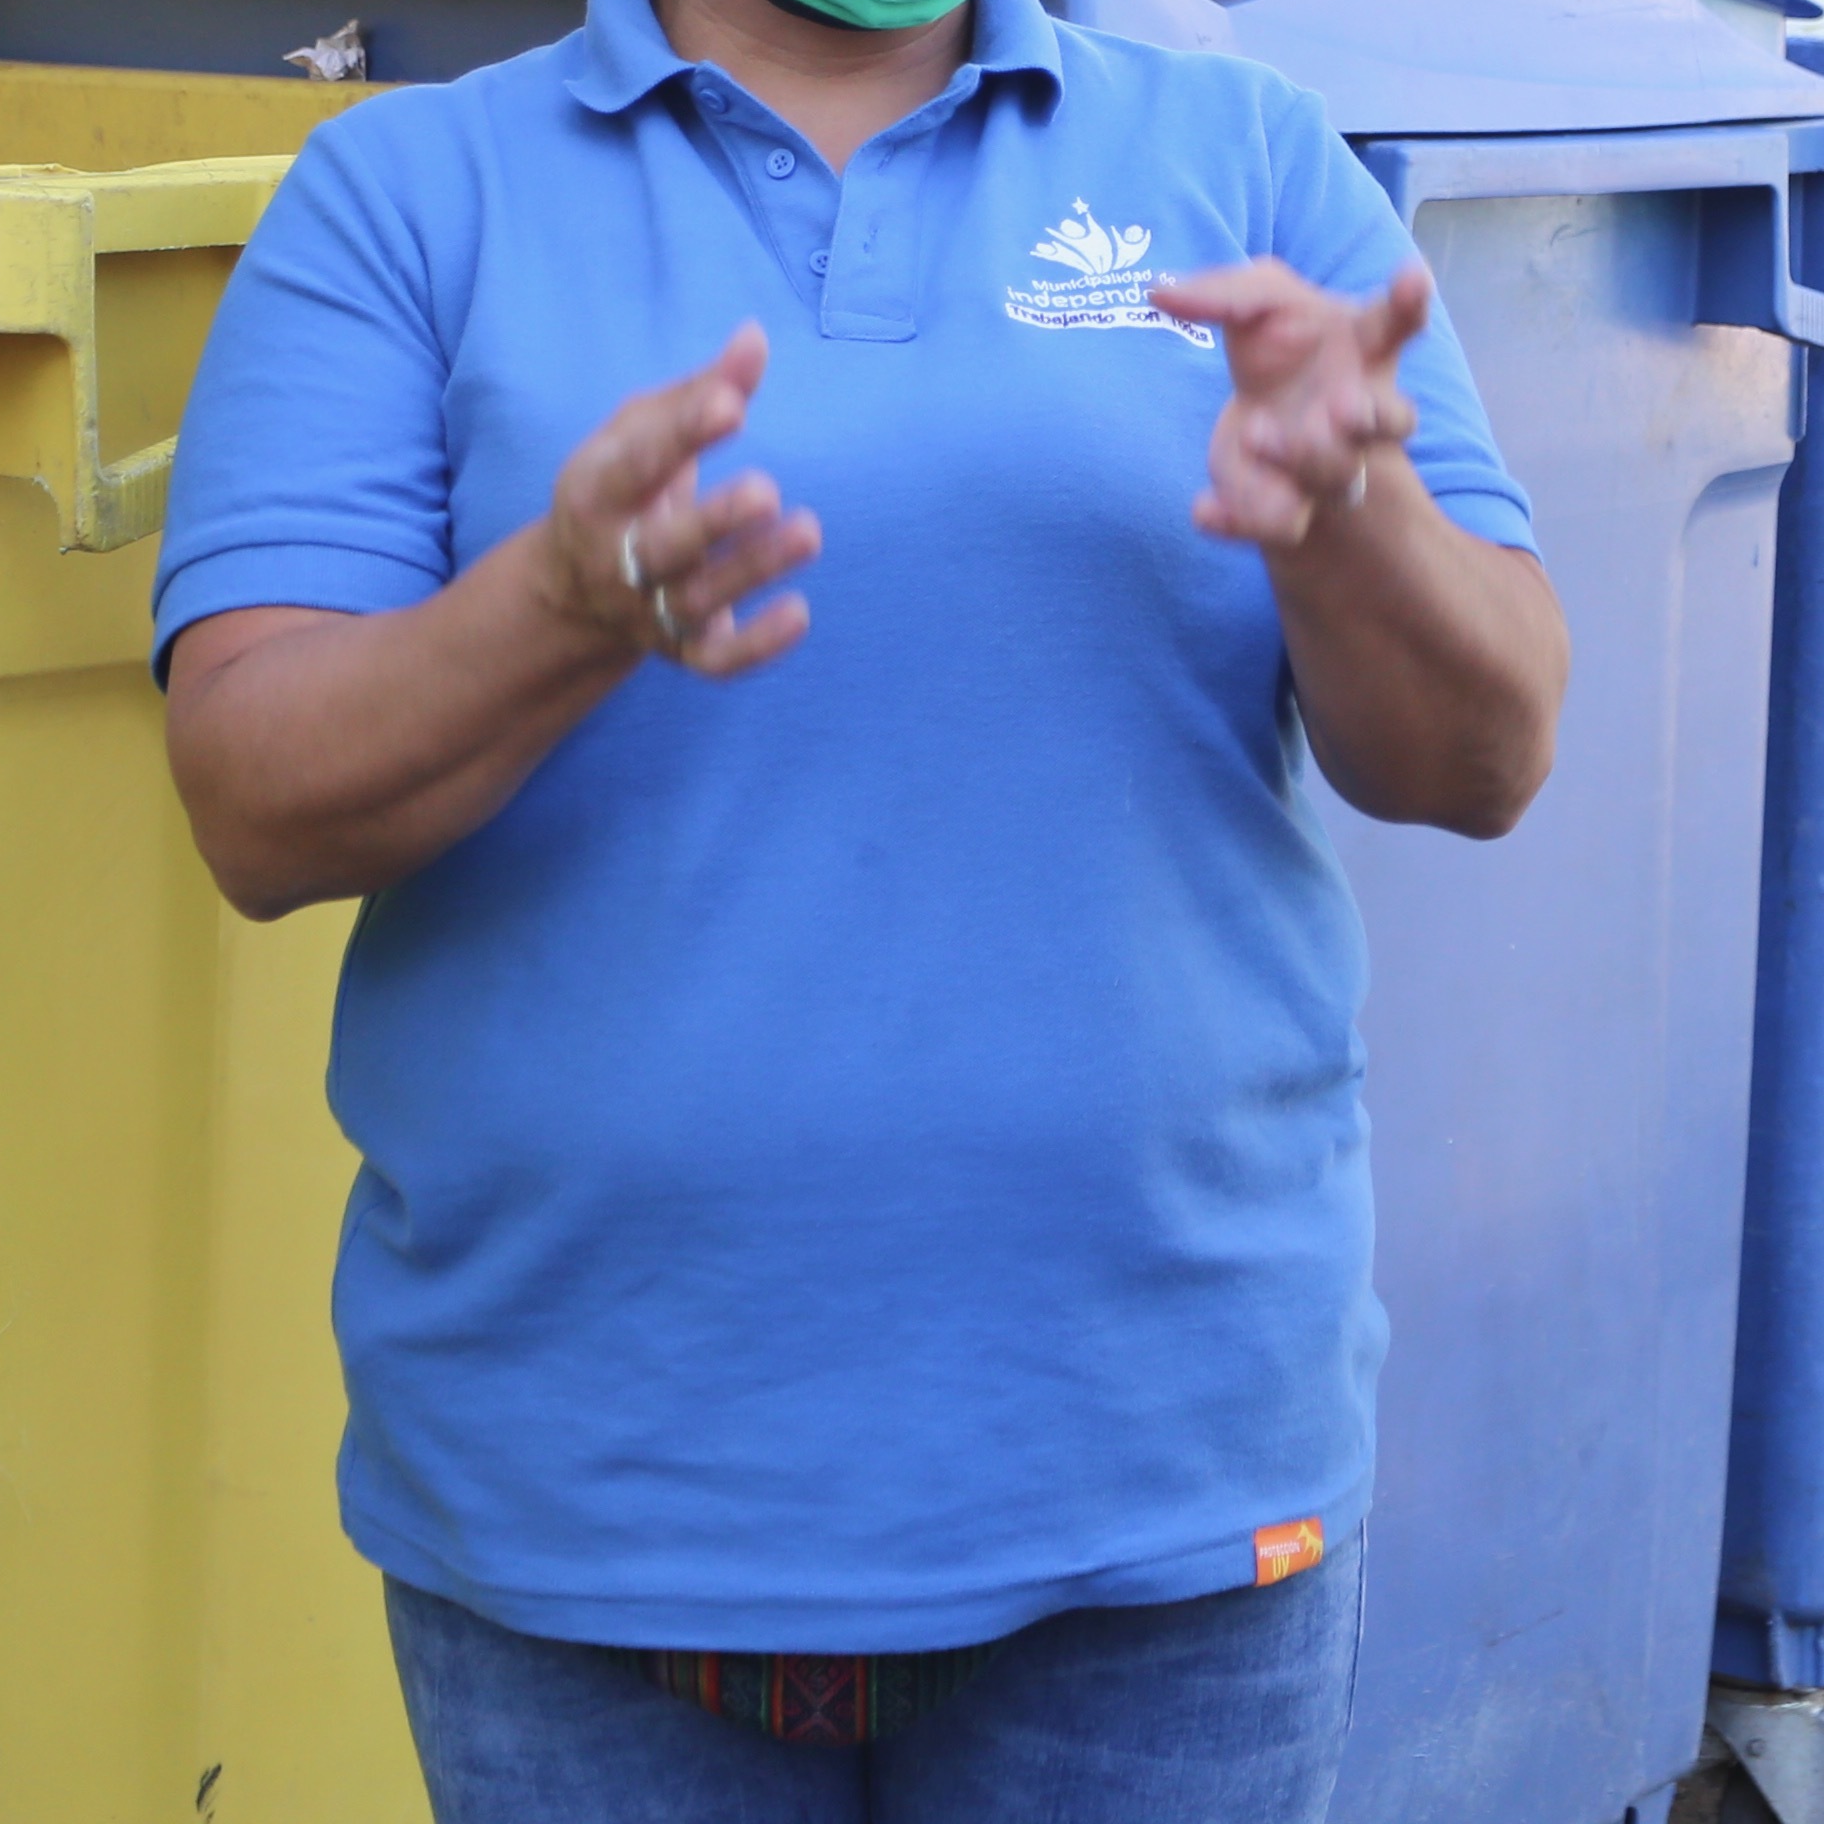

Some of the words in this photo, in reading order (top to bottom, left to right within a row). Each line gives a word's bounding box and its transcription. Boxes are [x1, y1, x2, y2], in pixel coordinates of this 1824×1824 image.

[1031, 268, 1153, 294] Municipalidad
[1126, 310, 1161, 324] con
[1272, 1554, 1290, 1580] UV
